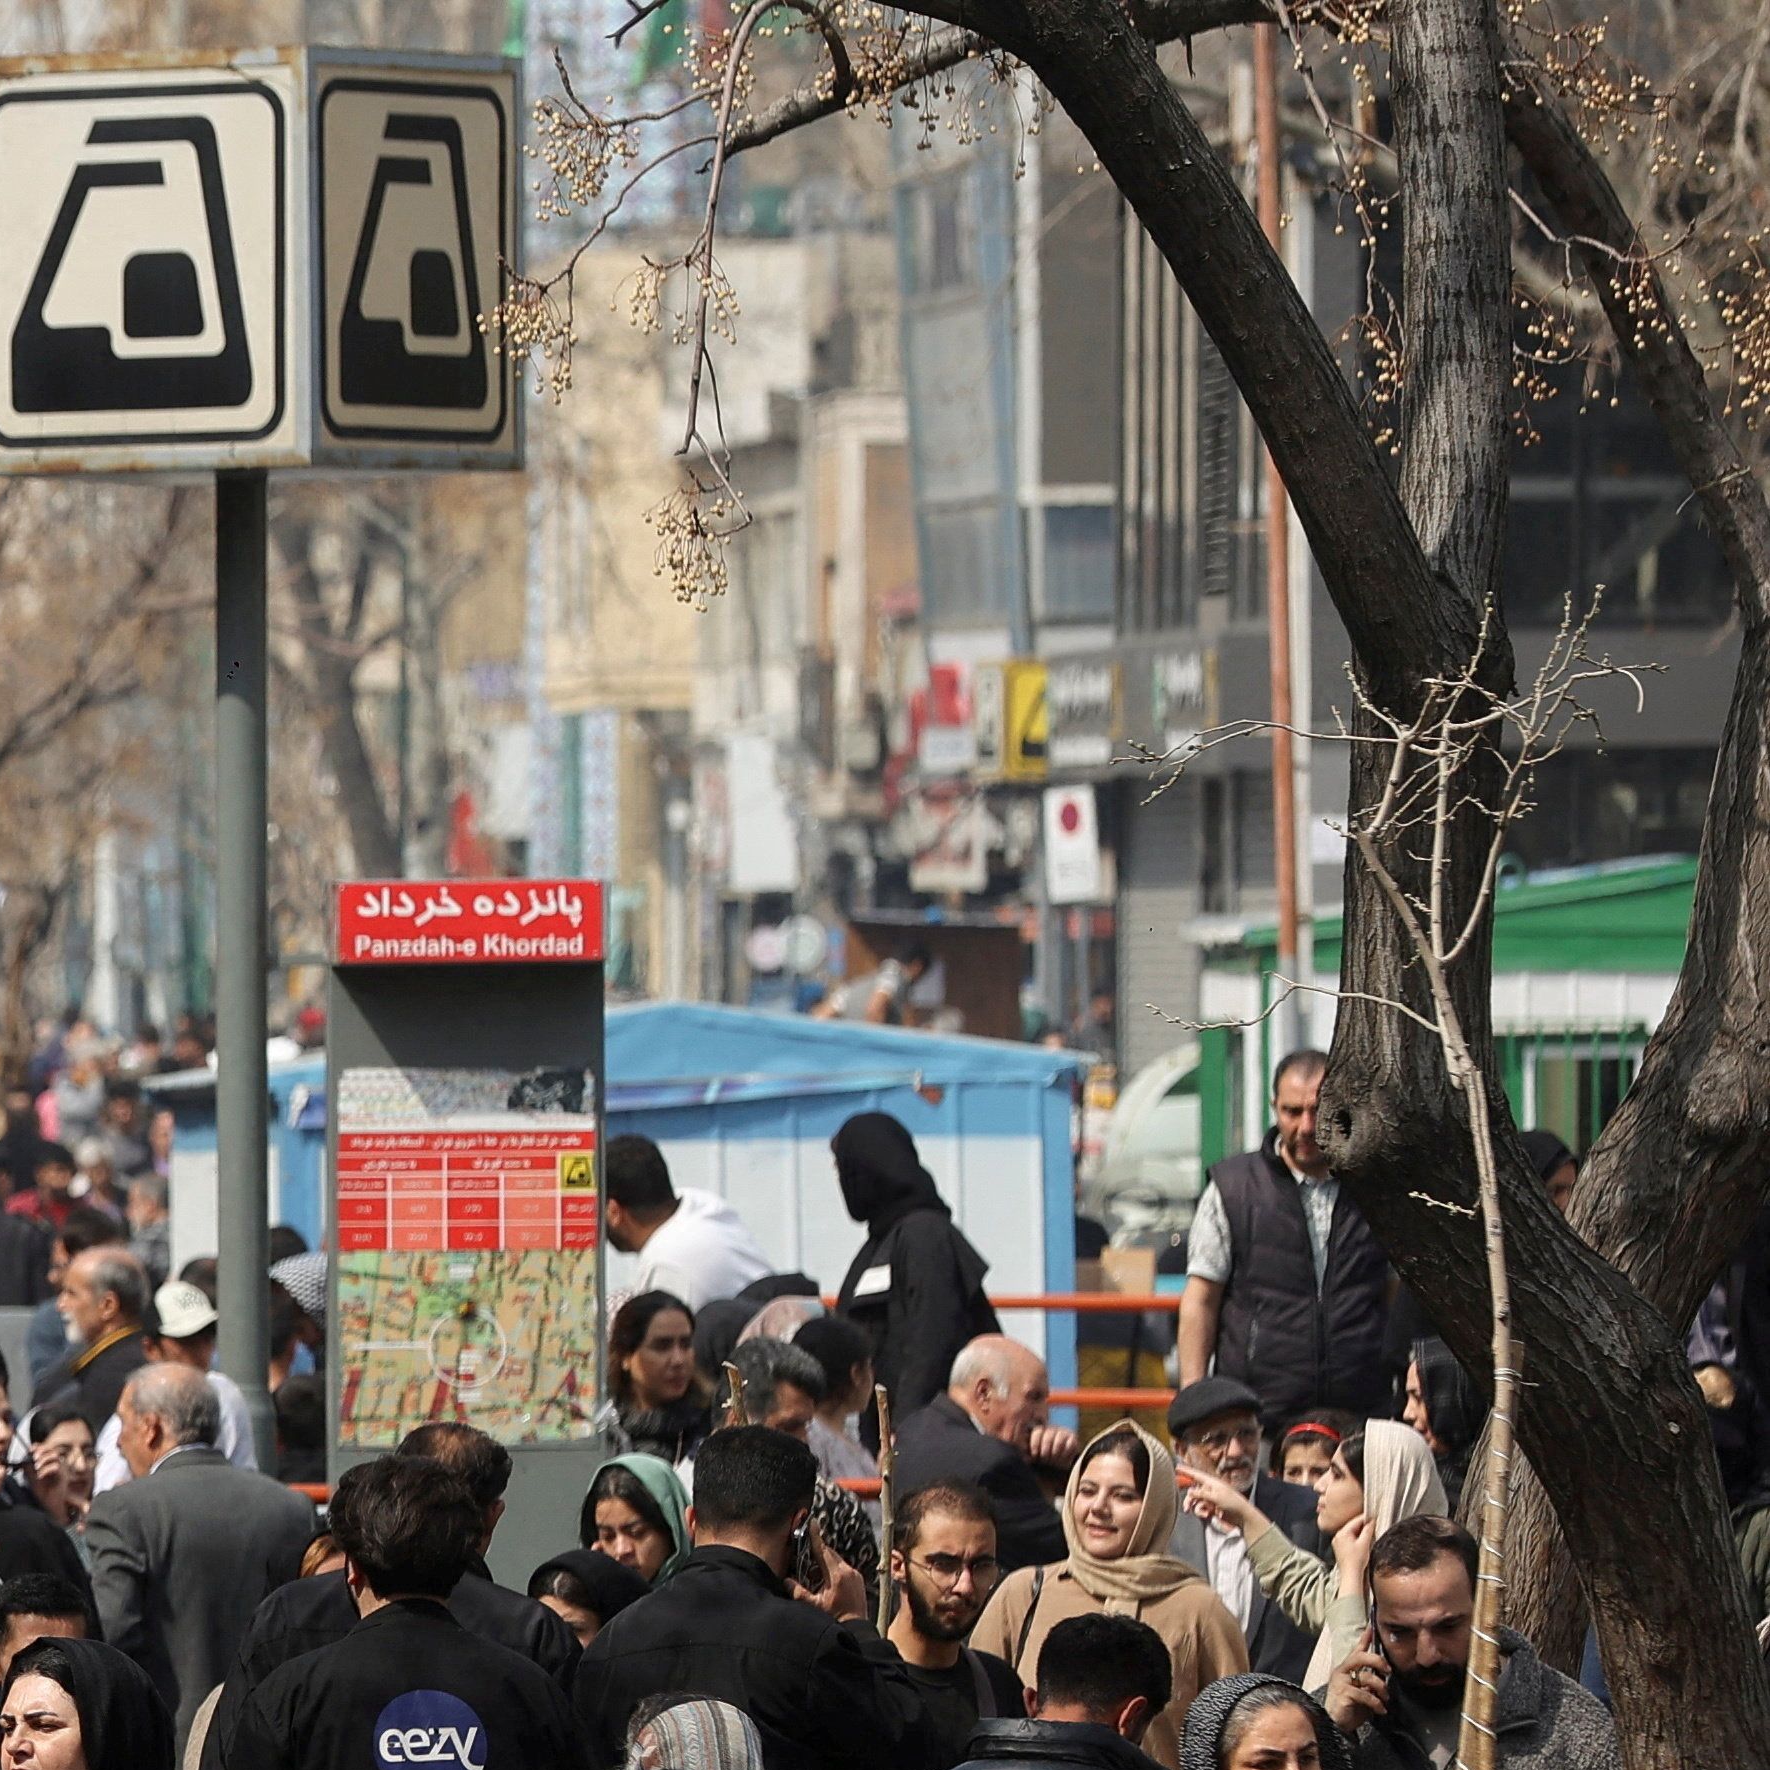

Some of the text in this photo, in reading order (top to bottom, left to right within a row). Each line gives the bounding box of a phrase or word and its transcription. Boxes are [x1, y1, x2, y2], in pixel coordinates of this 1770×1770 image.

[356, 884, 584, 929] پانزده خرداد
[354, 932, 585, 959] Panzdah-e Khordad
